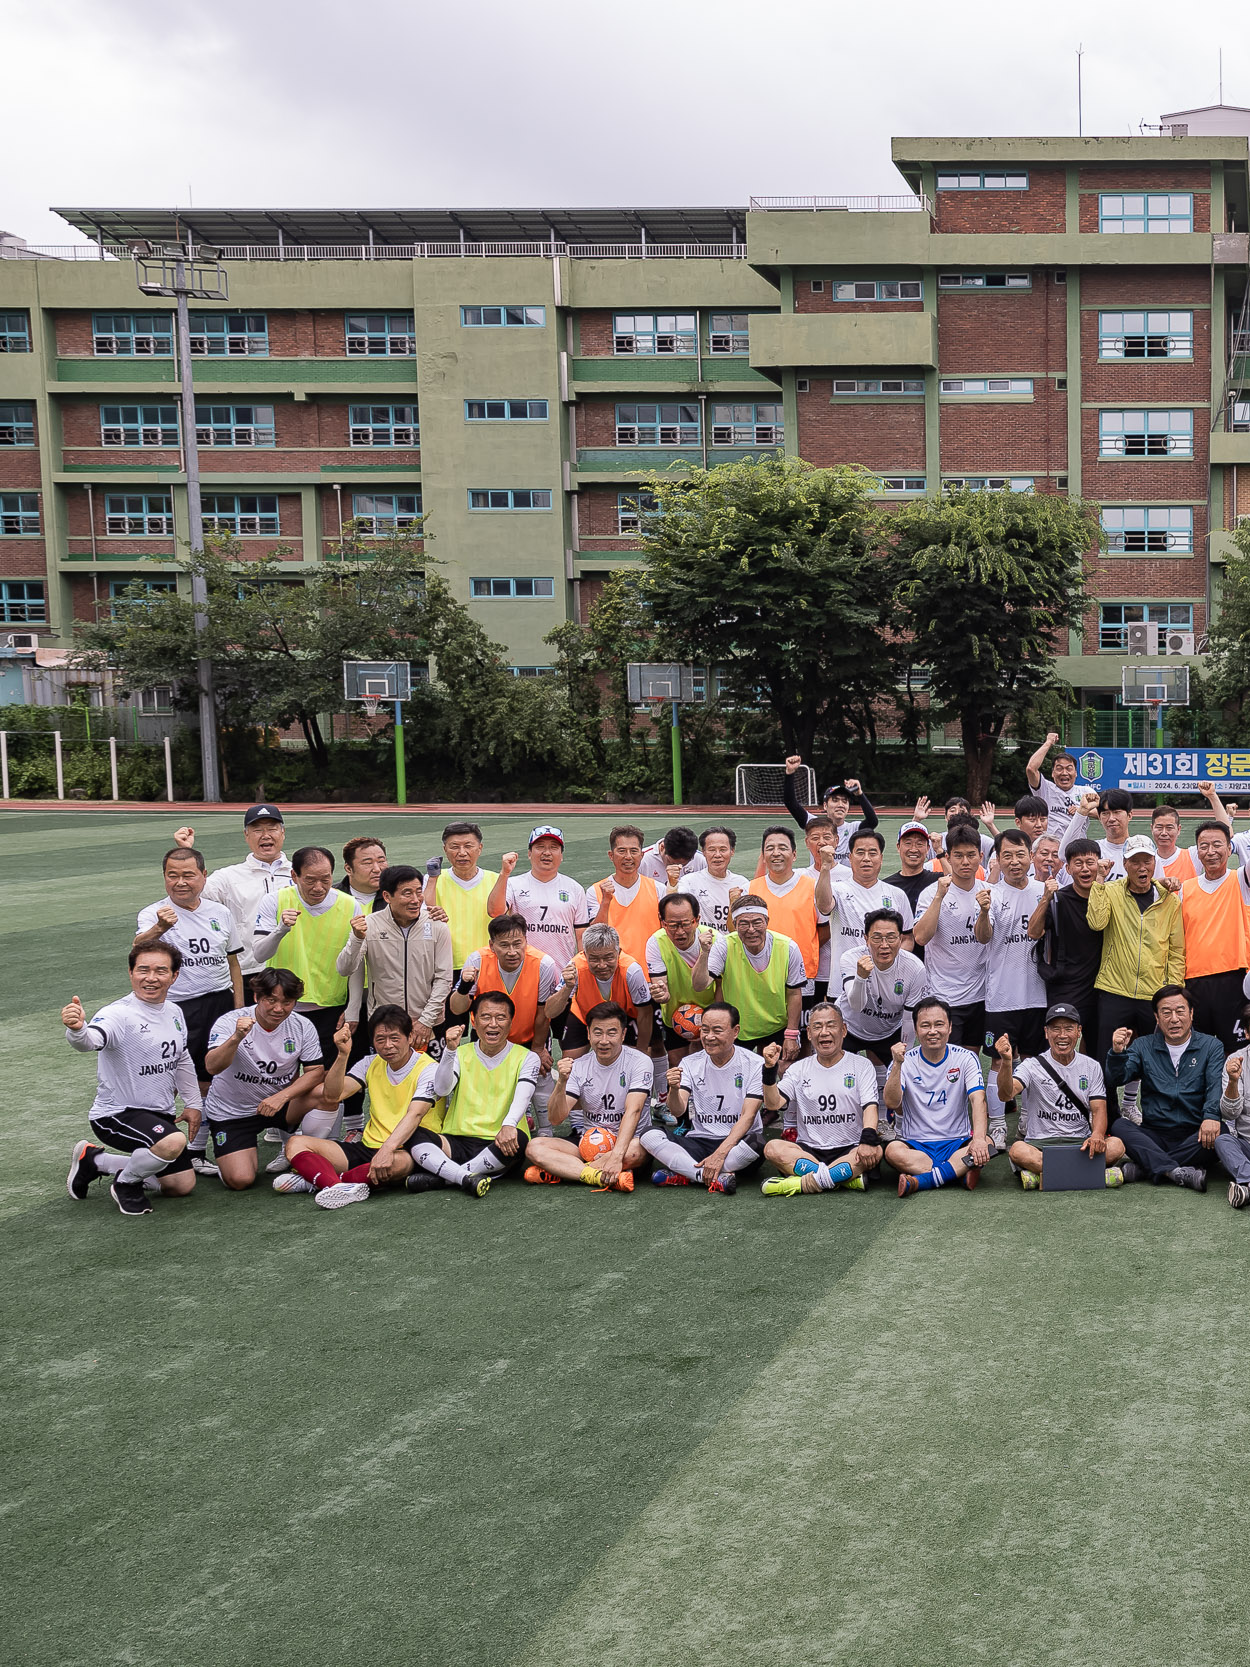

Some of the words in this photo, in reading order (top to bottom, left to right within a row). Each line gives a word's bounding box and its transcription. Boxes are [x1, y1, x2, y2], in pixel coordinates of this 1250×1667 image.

[1123, 752, 1198, 776] 제31회
[540, 906, 549, 920] 7
[526, 924, 536, 932] NG
[536, 924, 560, 933] MOON
[562, 925, 569, 934] FC
[840, 927, 860, 938] JANG
[188, 938, 210, 954] 50
[950, 936, 969, 944] JANG
[181, 958, 194, 967] NG
[162, 1040, 177, 1059] 21
[139, 1064, 164, 1076] JANG
[256, 1060, 278, 1074] 20
[234, 1072, 258, 1084] JANG
[601, 1094, 616, 1110] 12
[716, 1095, 724, 1112] 7
[818, 1094, 836, 1111] 99
[926, 1090, 948, 1106] 74
[1055, 1094, 1074, 1110] 48
[714, 1114, 738, 1124] MOON
[822, 1114, 846, 1124] MOON
[846, 1113, 856, 1122] FC
[1038, 1110, 1057, 1122] JANG
